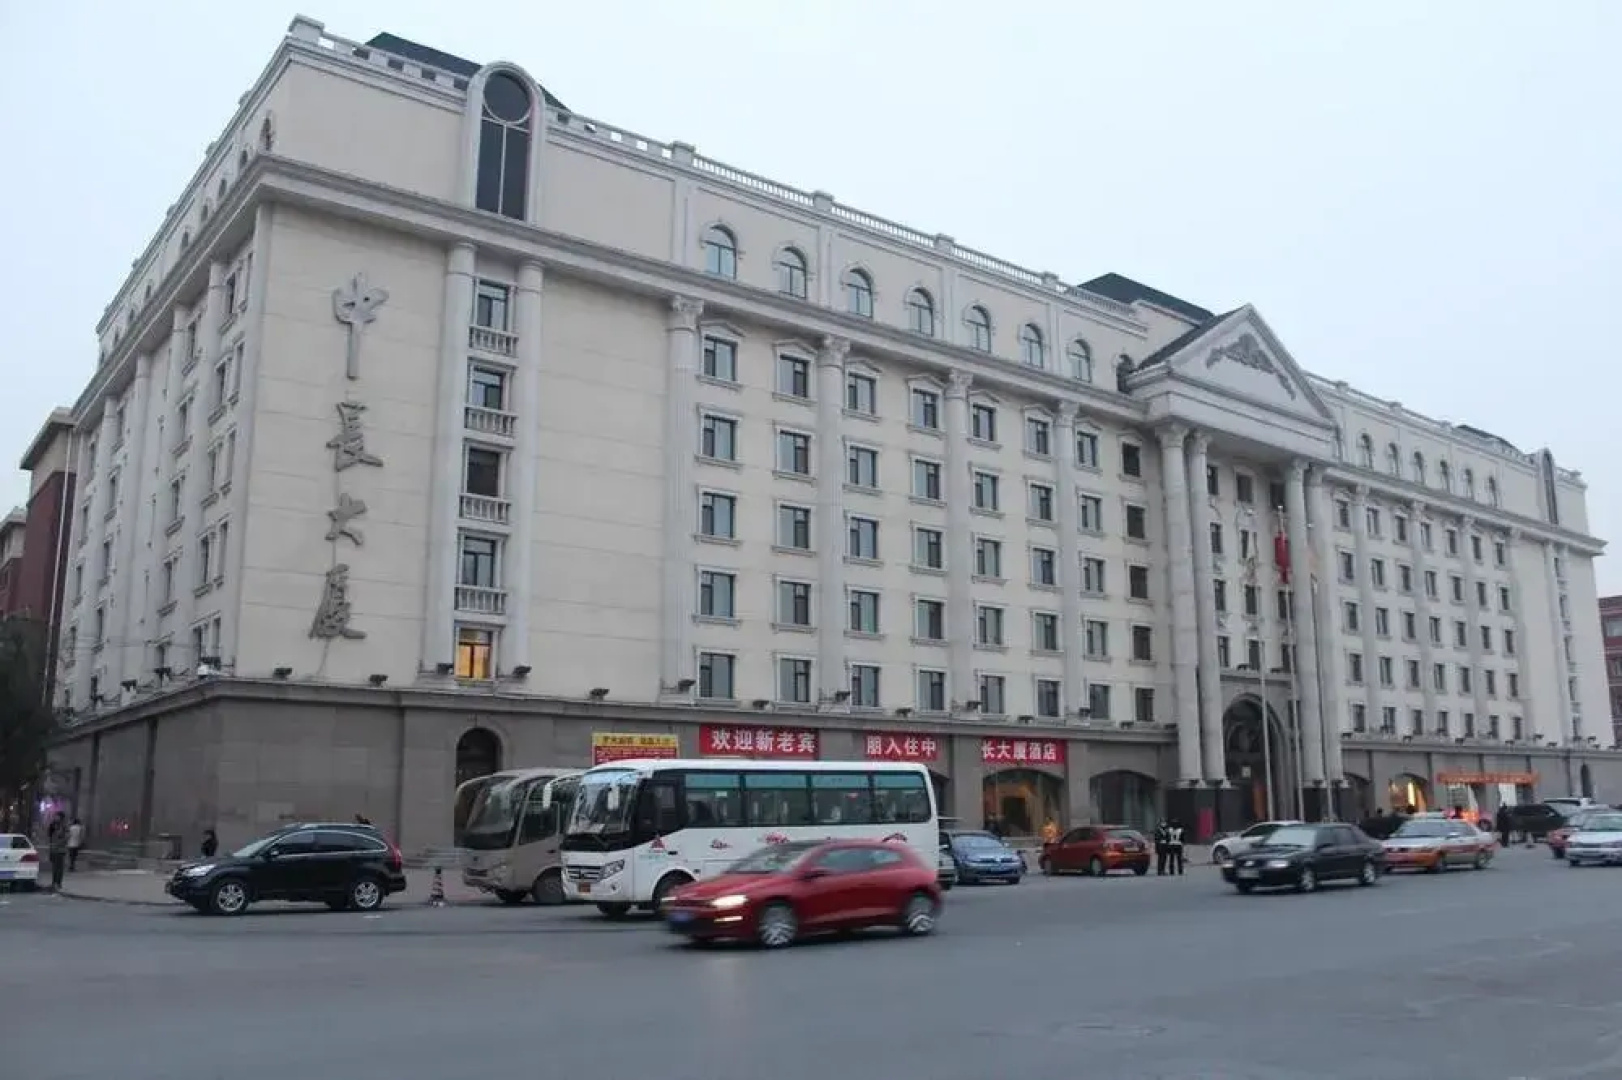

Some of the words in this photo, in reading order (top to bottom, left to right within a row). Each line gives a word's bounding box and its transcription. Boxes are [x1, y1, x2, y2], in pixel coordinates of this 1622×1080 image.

[711, 728, 815, 755] 欢迎新老宾
[866, 734, 937, 756] 朋入住中
[981, 740, 1057, 761] 长大厦酒店
